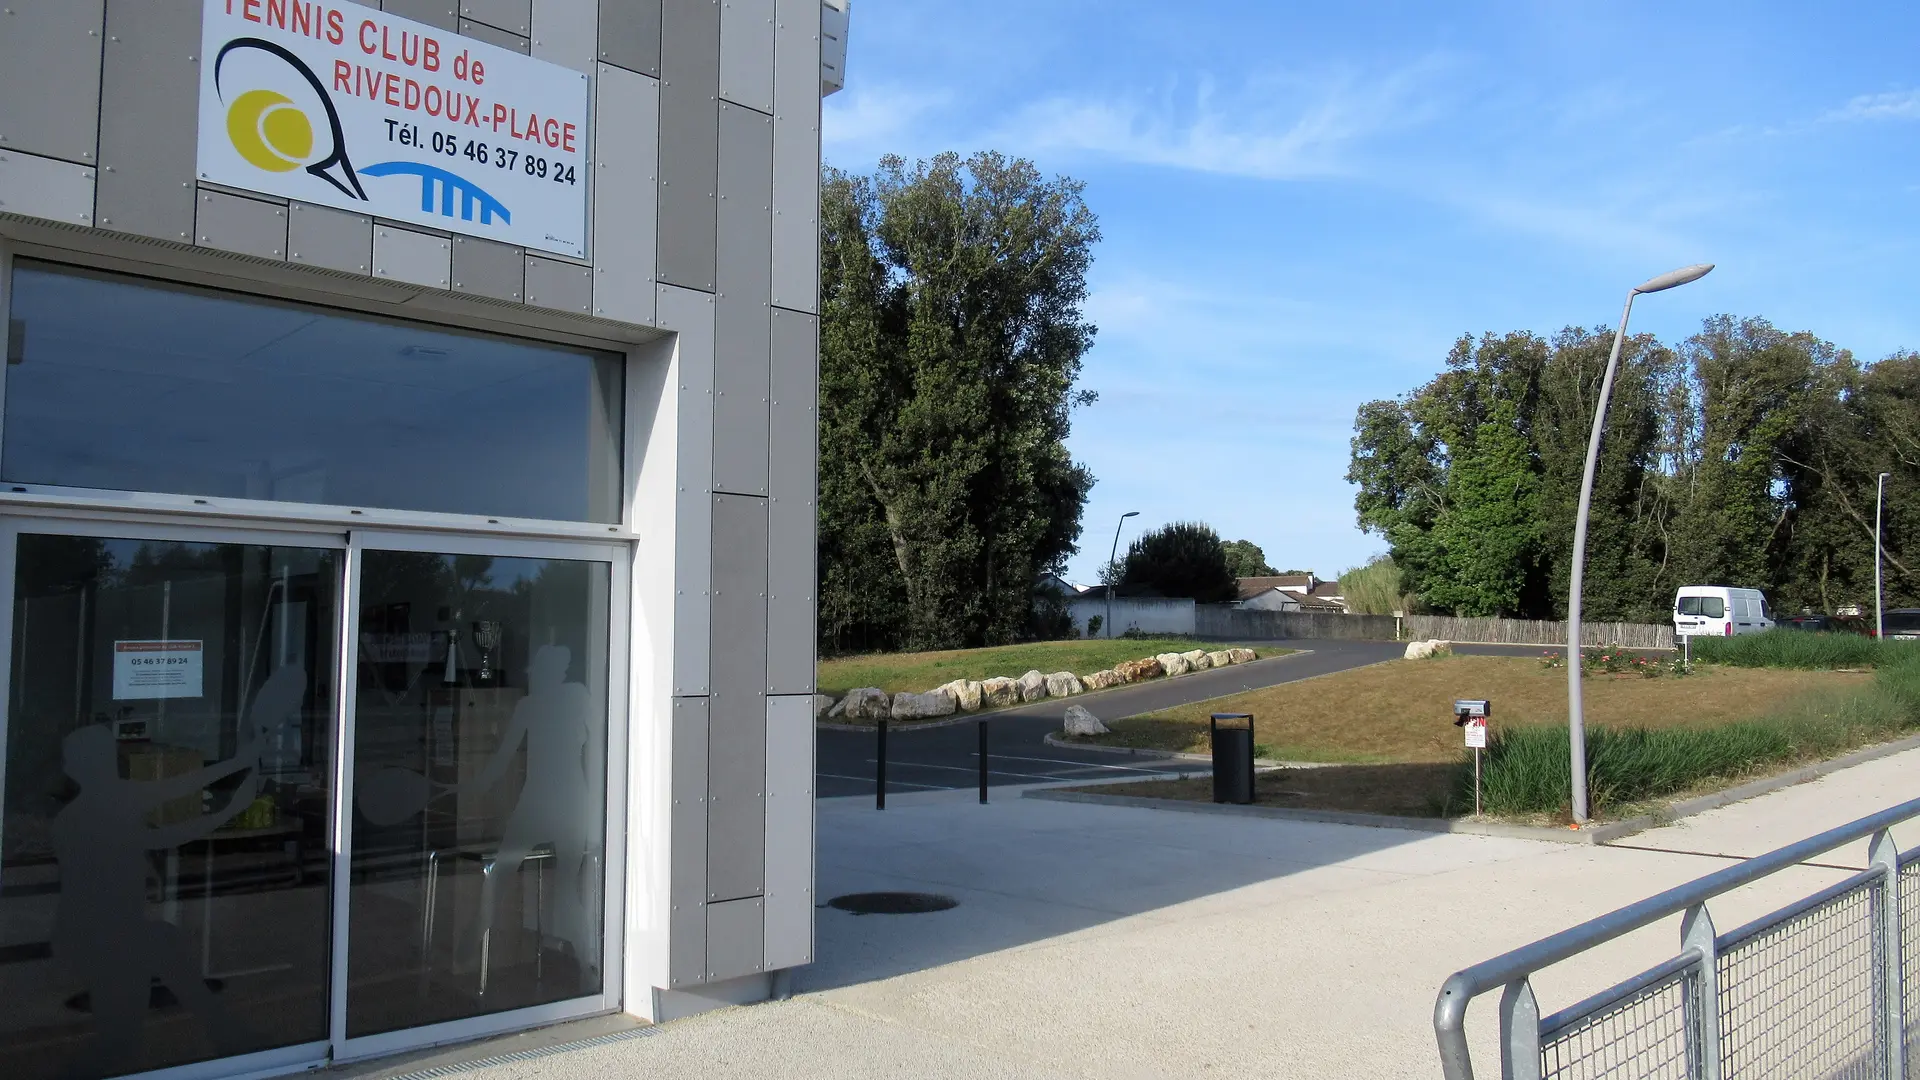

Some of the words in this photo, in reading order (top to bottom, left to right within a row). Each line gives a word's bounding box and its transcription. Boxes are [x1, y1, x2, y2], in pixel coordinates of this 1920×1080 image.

[358, 19, 441, 73] CLUB
[453, 49, 485, 86] de
[333, 59, 577, 153] RIVEDOUX-PLAGE
[384, 118, 425, 149] Tél.
[432, 131, 458, 157] 05
[463, 140, 489, 164] 46
[495, 147, 519, 171] 37
[525, 154, 548, 179] 89
[553, 162, 577, 186] 24
